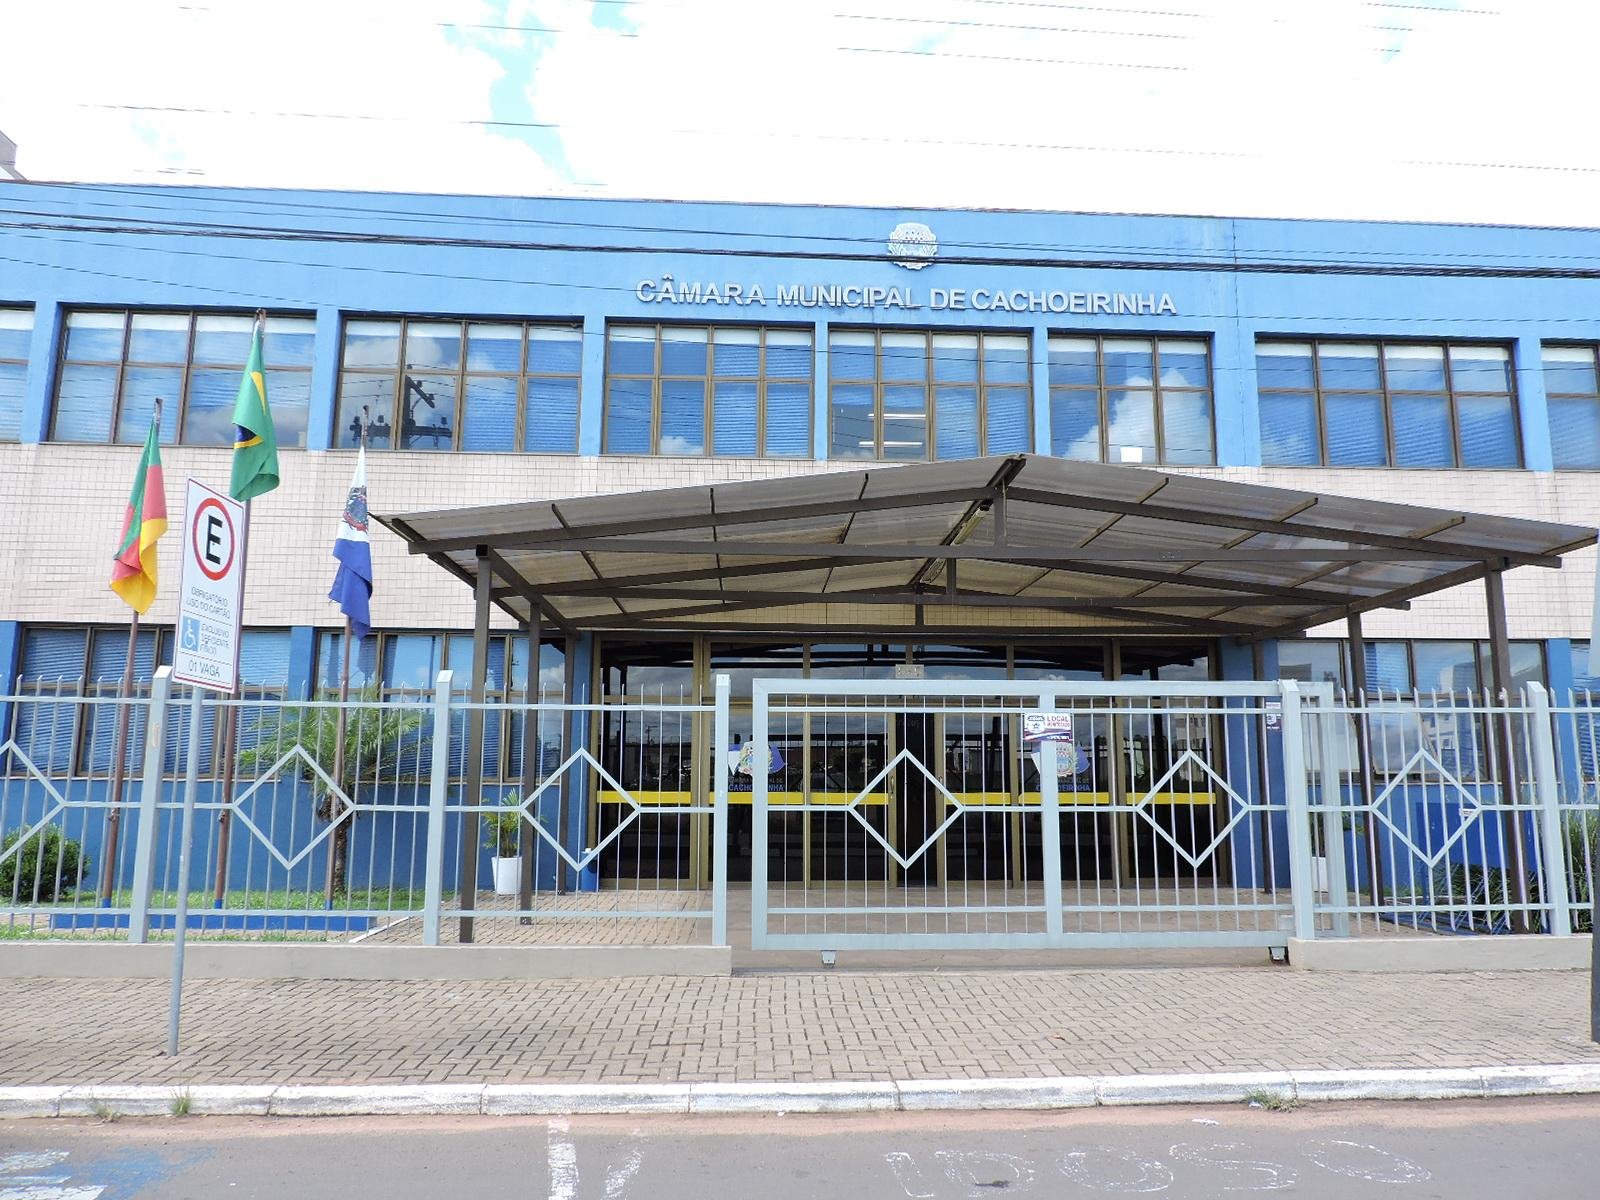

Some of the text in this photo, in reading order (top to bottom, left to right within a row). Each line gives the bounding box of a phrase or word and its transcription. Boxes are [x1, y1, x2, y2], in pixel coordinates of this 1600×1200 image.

[635, 273, 1178, 315] CÂMARA MUNICIPAL DE CACHOEIRINHA
[206, 514, 223, 565] E
[188, 660, 221, 678] 01 VAGA
